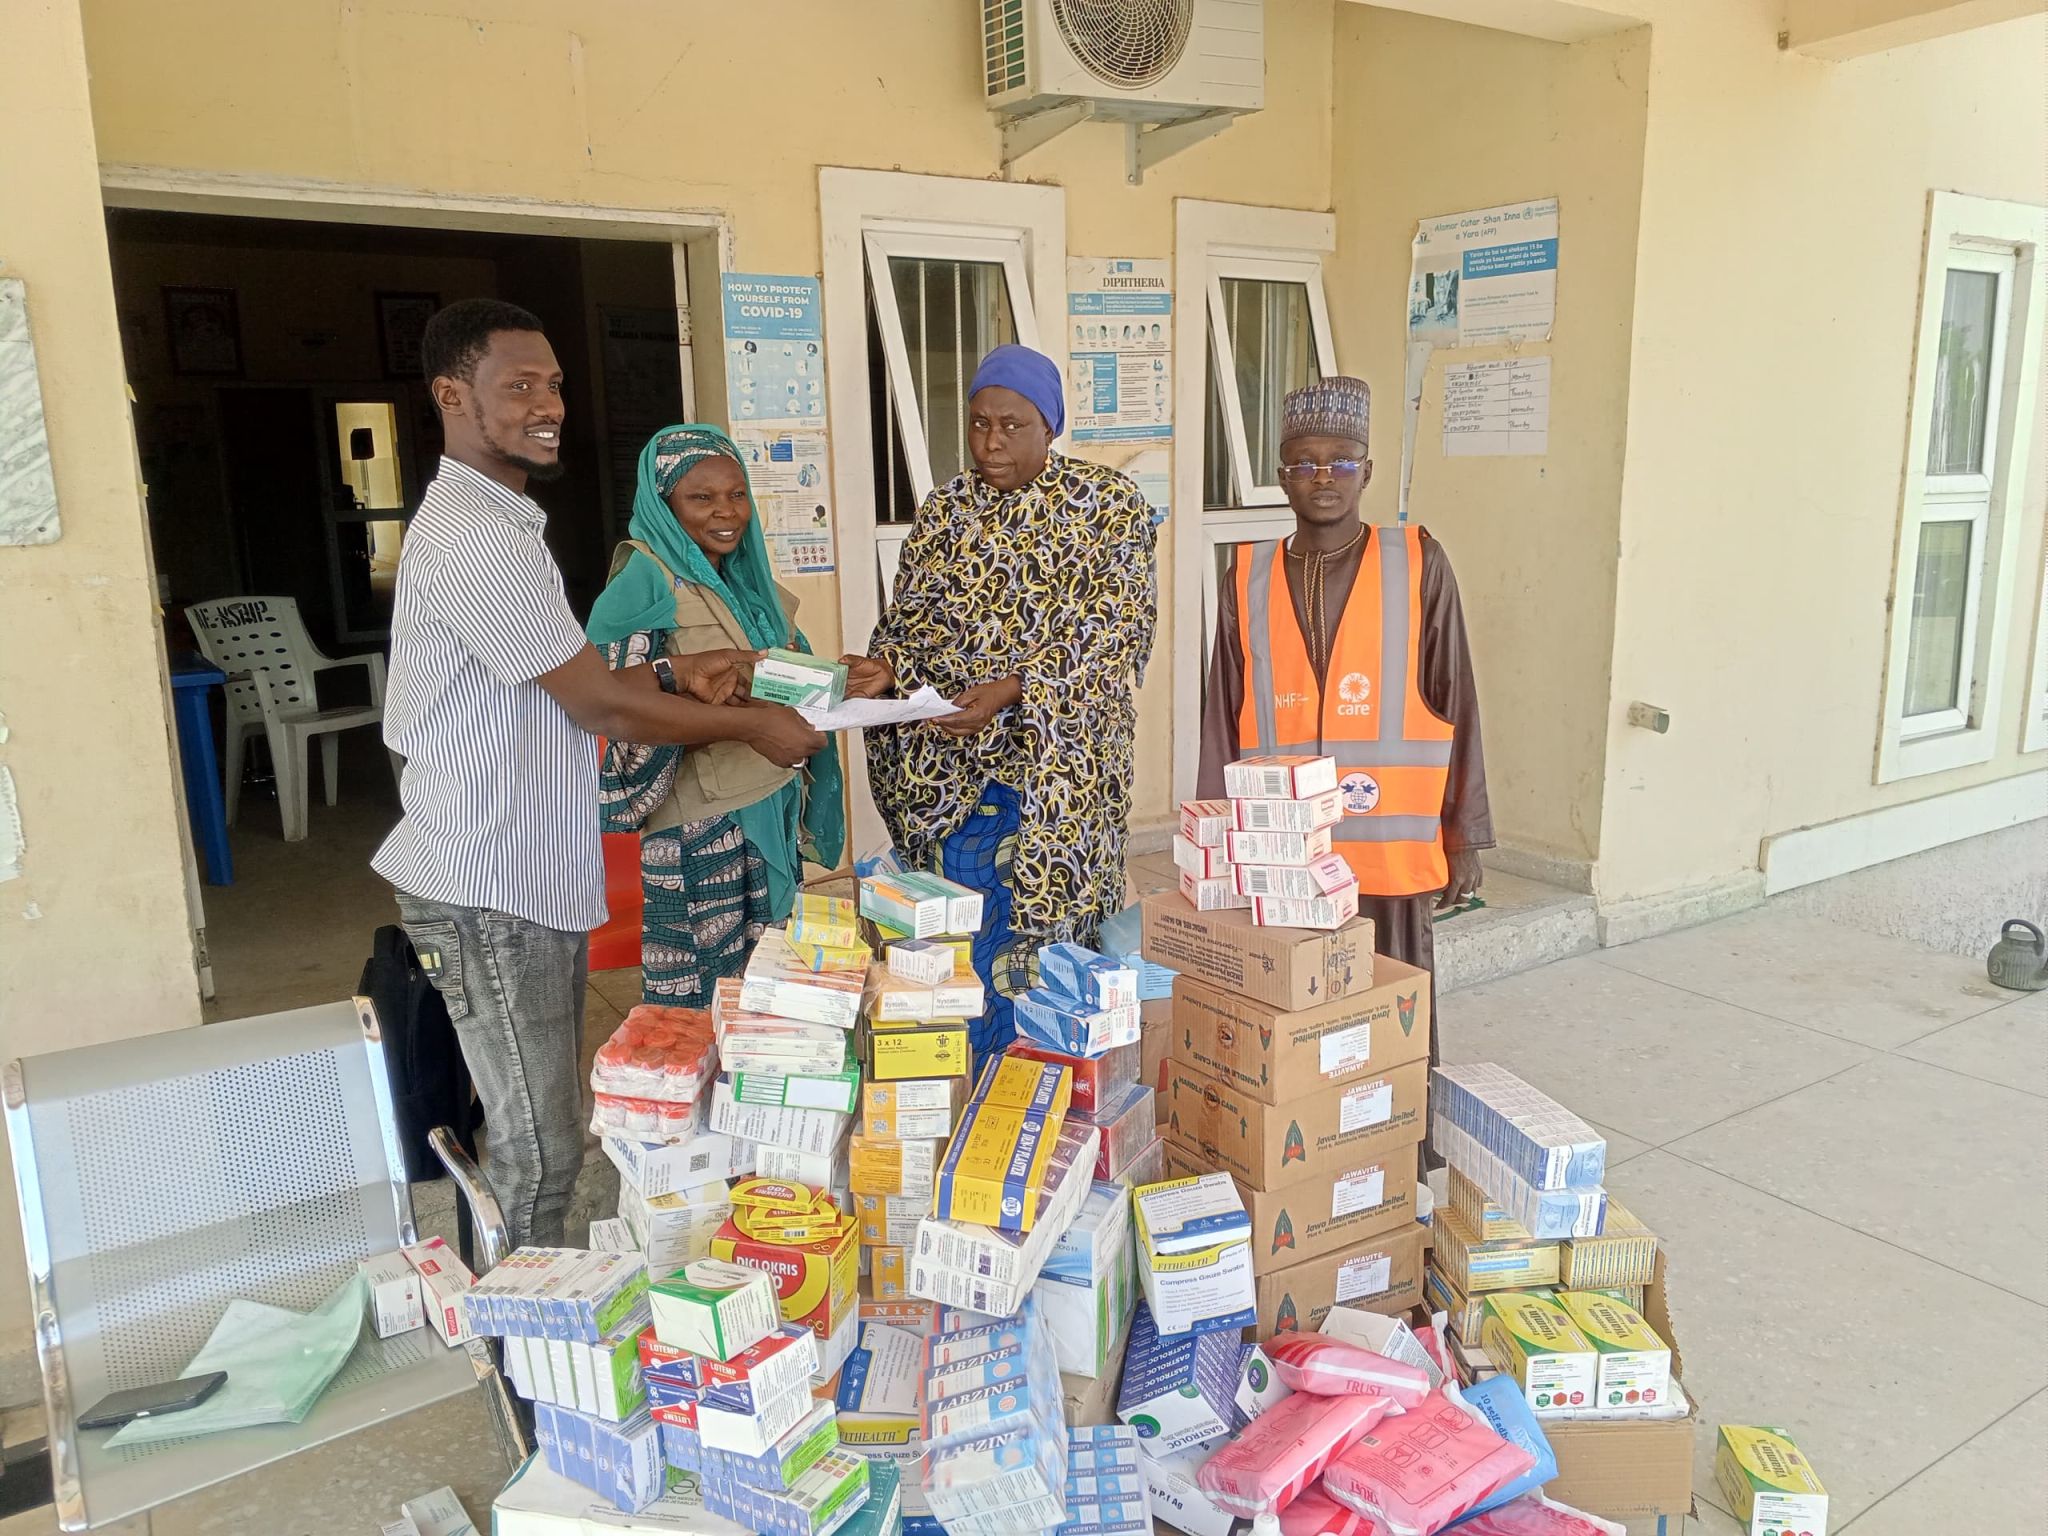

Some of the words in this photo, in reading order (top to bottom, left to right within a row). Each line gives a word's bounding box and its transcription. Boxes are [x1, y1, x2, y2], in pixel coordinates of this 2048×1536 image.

[1461, 219, 1480, 227] Cutar
[1483, 215, 1501, 224] Shan
[727, 284, 752, 292] HOW
[755, 285, 767, 293] TO
[770, 285, 812, 294] PROTECT
[1103, 277, 1165, 288] DIPHTHERIA
[731, 294, 780, 303] YOURSELF
[783, 296, 809, 304] FROM
[740, 305, 803, 319] COVID-19
[1337, 704, 1370, 716] care
[1371, 1009, 1392, 1022] Jawa
[1290, 1030, 1322, 1046] Limited
[1328, 1063, 1365, 1079] JAWAVITE
[1346, 1079, 1385, 1096] JAWAVITE
[1316, 1133, 1336, 1146] Jawa
[1010, 1147, 1031, 1177] PLASTER
[1341, 1164, 1379, 1180] JAWAVITE
[1140, 1181, 1189, 1194] FITHEALTH
[1144, 1190, 1179, 1201] Compress
[1181, 1185, 1202, 1194] Gauze
[1306, 1221, 1326, 1233] Jawa
[736, 1256, 798, 1276] DICLOKRIS
[1158, 1257, 1208, 1270] FITHEALTH
[1344, 1252, 1383, 1266] JAWAVITE
[1160, 1276, 1197, 1286] Compress
[1199, 1271, 1221, 1281] Gauze
[1222, 1263, 1245, 1275] Swabs
[939, 1320, 1015, 1344] LABZINE
[650, 1344, 678, 1355] LOTEMP
[1149, 1342, 1192, 1364] GASTROLOC
[710, 1362, 736, 1374] LOTEMP
[933, 1348, 1009, 1378] LABZINE
[1146, 1354, 1190, 1376] GASTROLOC
[1144, 1365, 1189, 1388] GASTROLOC
[1141, 1377, 1188, 1400] GASTROLOC
[1346, 1380, 1384, 1396] TRUST
[936, 1380, 1015, 1413] LABZINE
[1480, 1393, 1492, 1406] 10
[1487, 1405, 1501, 1422] self
[662, 1413, 690, 1424] LOTEMP
[1167, 1424, 1224, 1450] GASTROLOC
[884, 1451, 910, 1459] Gauze
[1172, 1499, 1183, 1510] Ag
